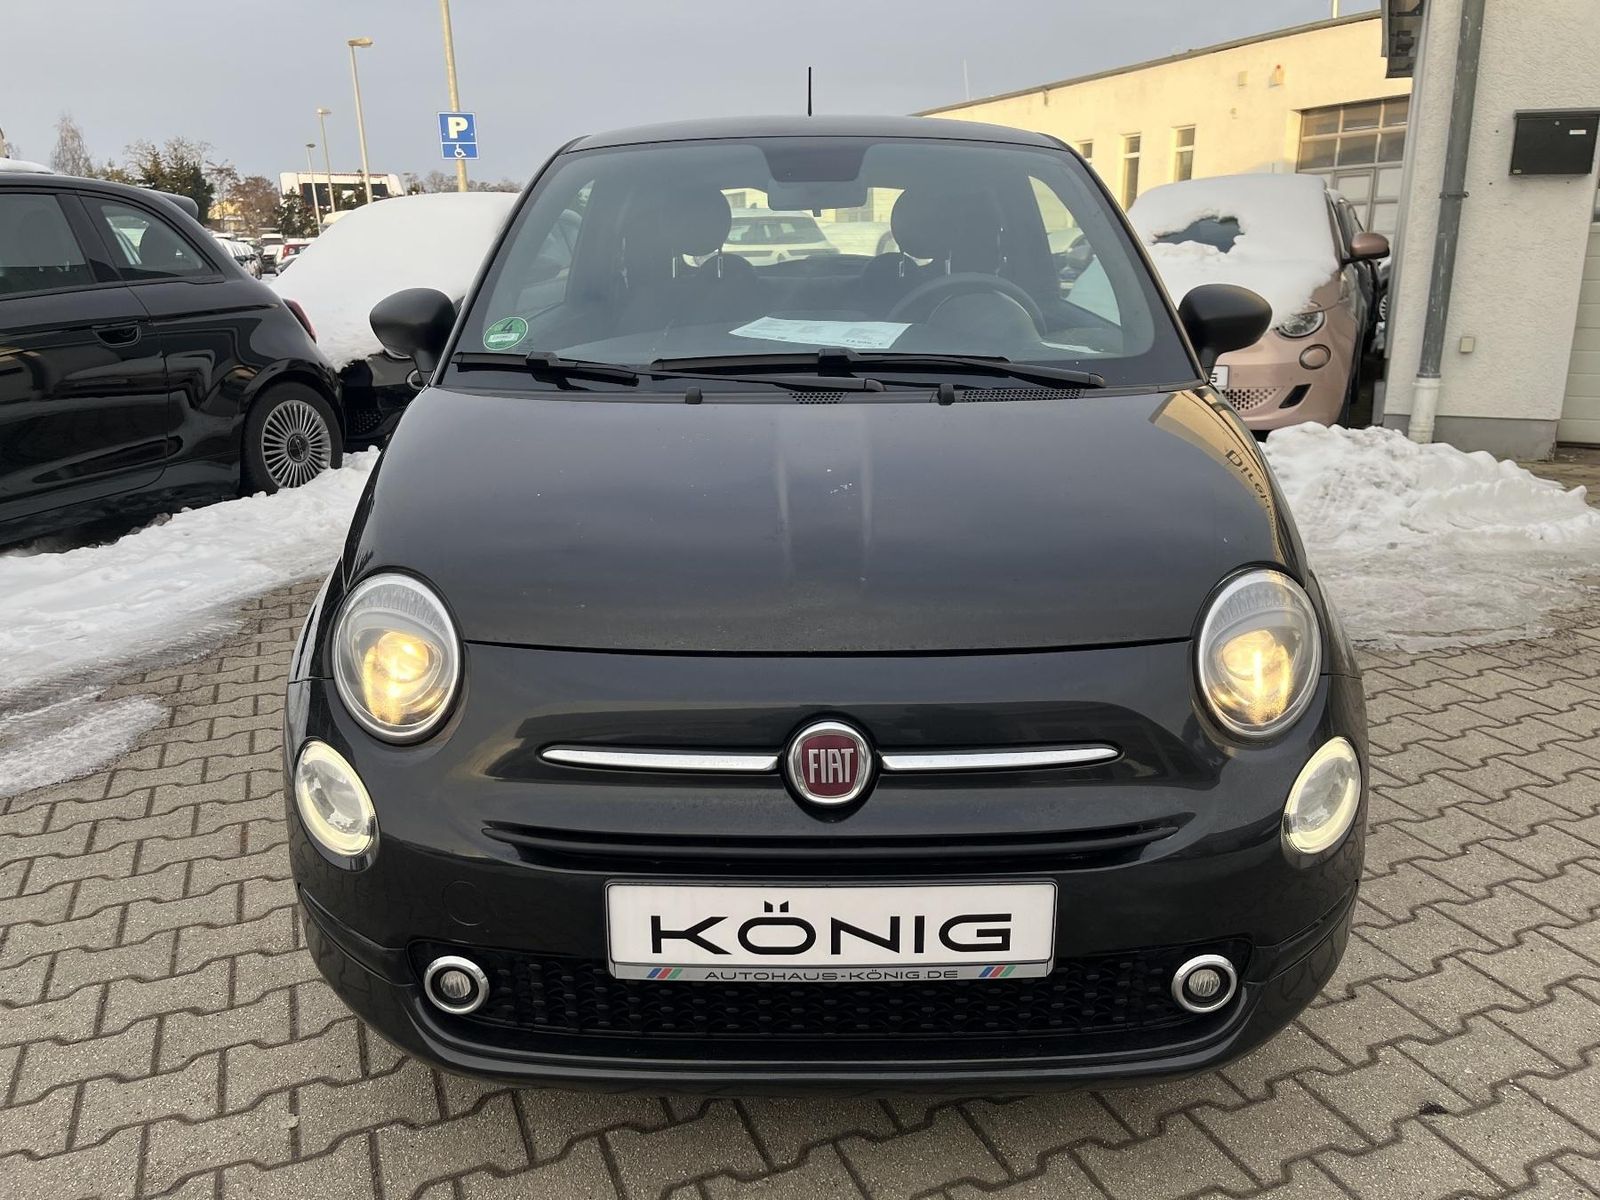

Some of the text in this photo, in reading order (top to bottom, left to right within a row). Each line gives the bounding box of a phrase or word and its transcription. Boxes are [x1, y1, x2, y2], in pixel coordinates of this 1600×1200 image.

[447, 116, 469, 139] P
[501, 319, 513, 333] 4
[808, 748, 855, 784] FIAT
[650, 900, 1012, 956] KÖNIG
[704, 968, 959, 982] AUTOHAUS-KÖNIG.DE
